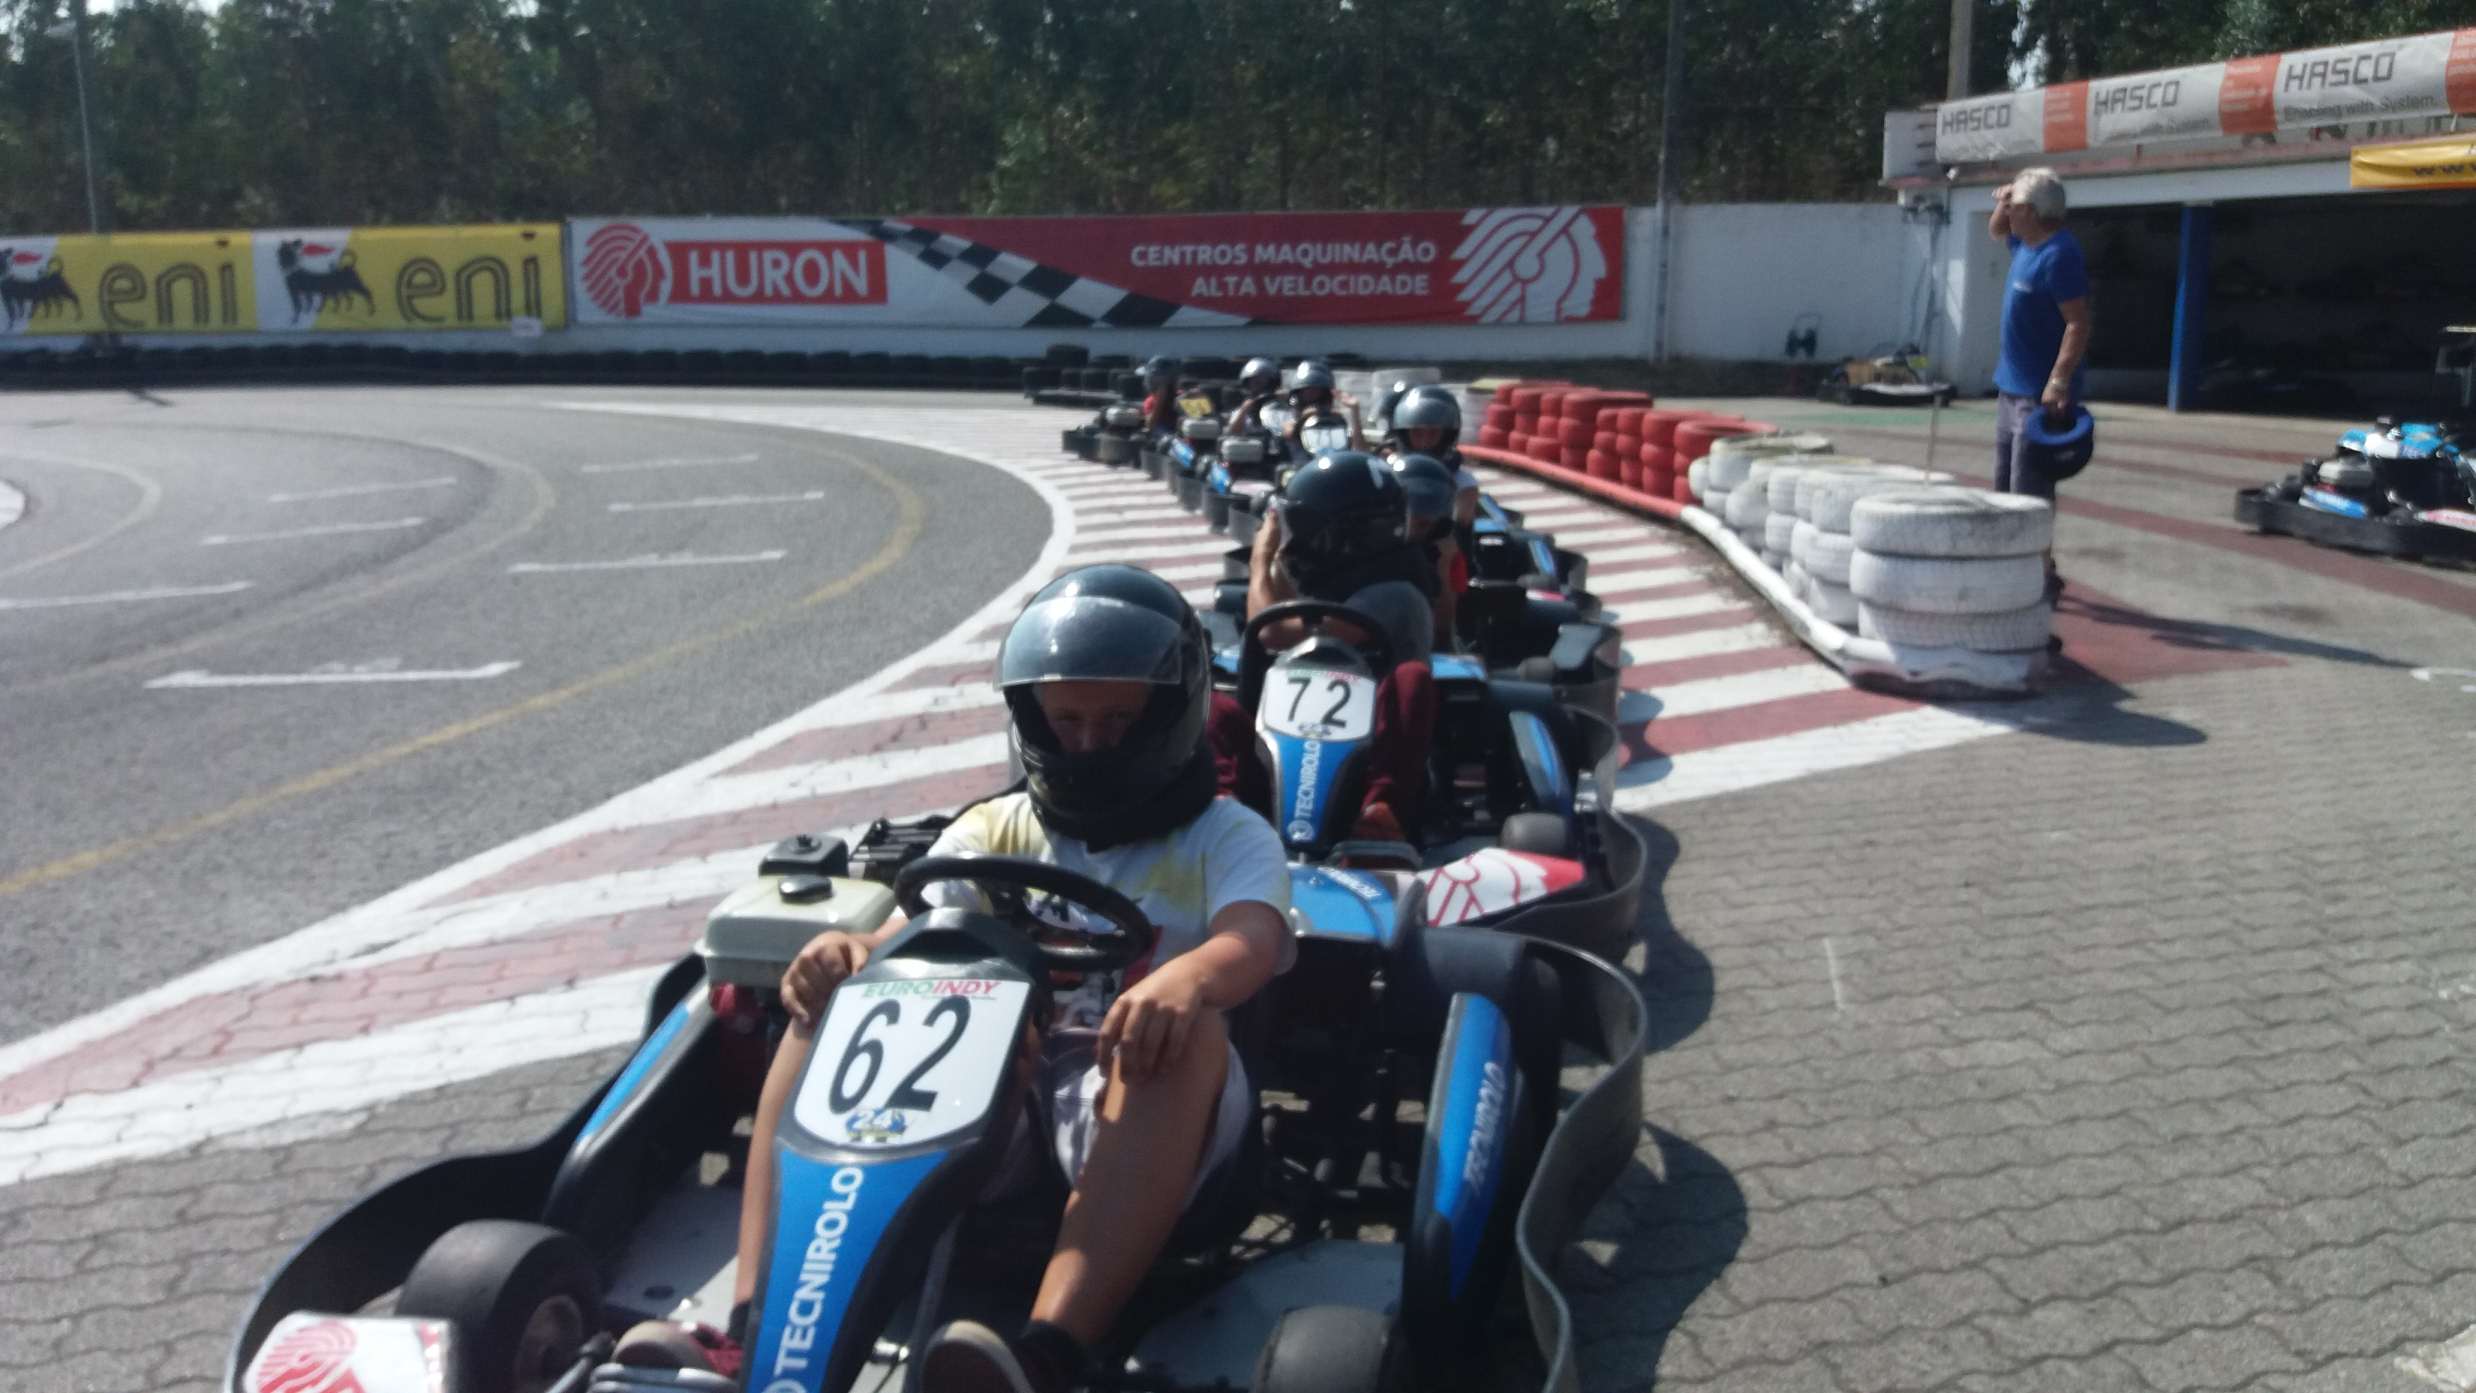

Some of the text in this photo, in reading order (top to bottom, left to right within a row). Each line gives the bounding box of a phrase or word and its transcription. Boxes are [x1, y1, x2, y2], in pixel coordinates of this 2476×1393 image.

[2283, 51, 2397, 93] HASCO
[1941, 103, 2011, 135] HASCO
[2094, 80, 2180, 116] HASCO
[398, 230, 543, 322] eni
[689, 248, 869, 298] HURON
[1130, 237, 1437, 269] CENTROS MAQUINAÇÃO
[100, 238, 239, 327] eni
[1191, 274, 1430, 297] ALTA VELOCIDADE
[1287, 677, 1352, 729] 72
[1293, 739, 1322, 820] TECNIROLO
[862, 979, 1001, 999] EUROINDY
[829, 994, 972, 1115] 62
[773, 1166, 865, 1377] TECNIROLO
